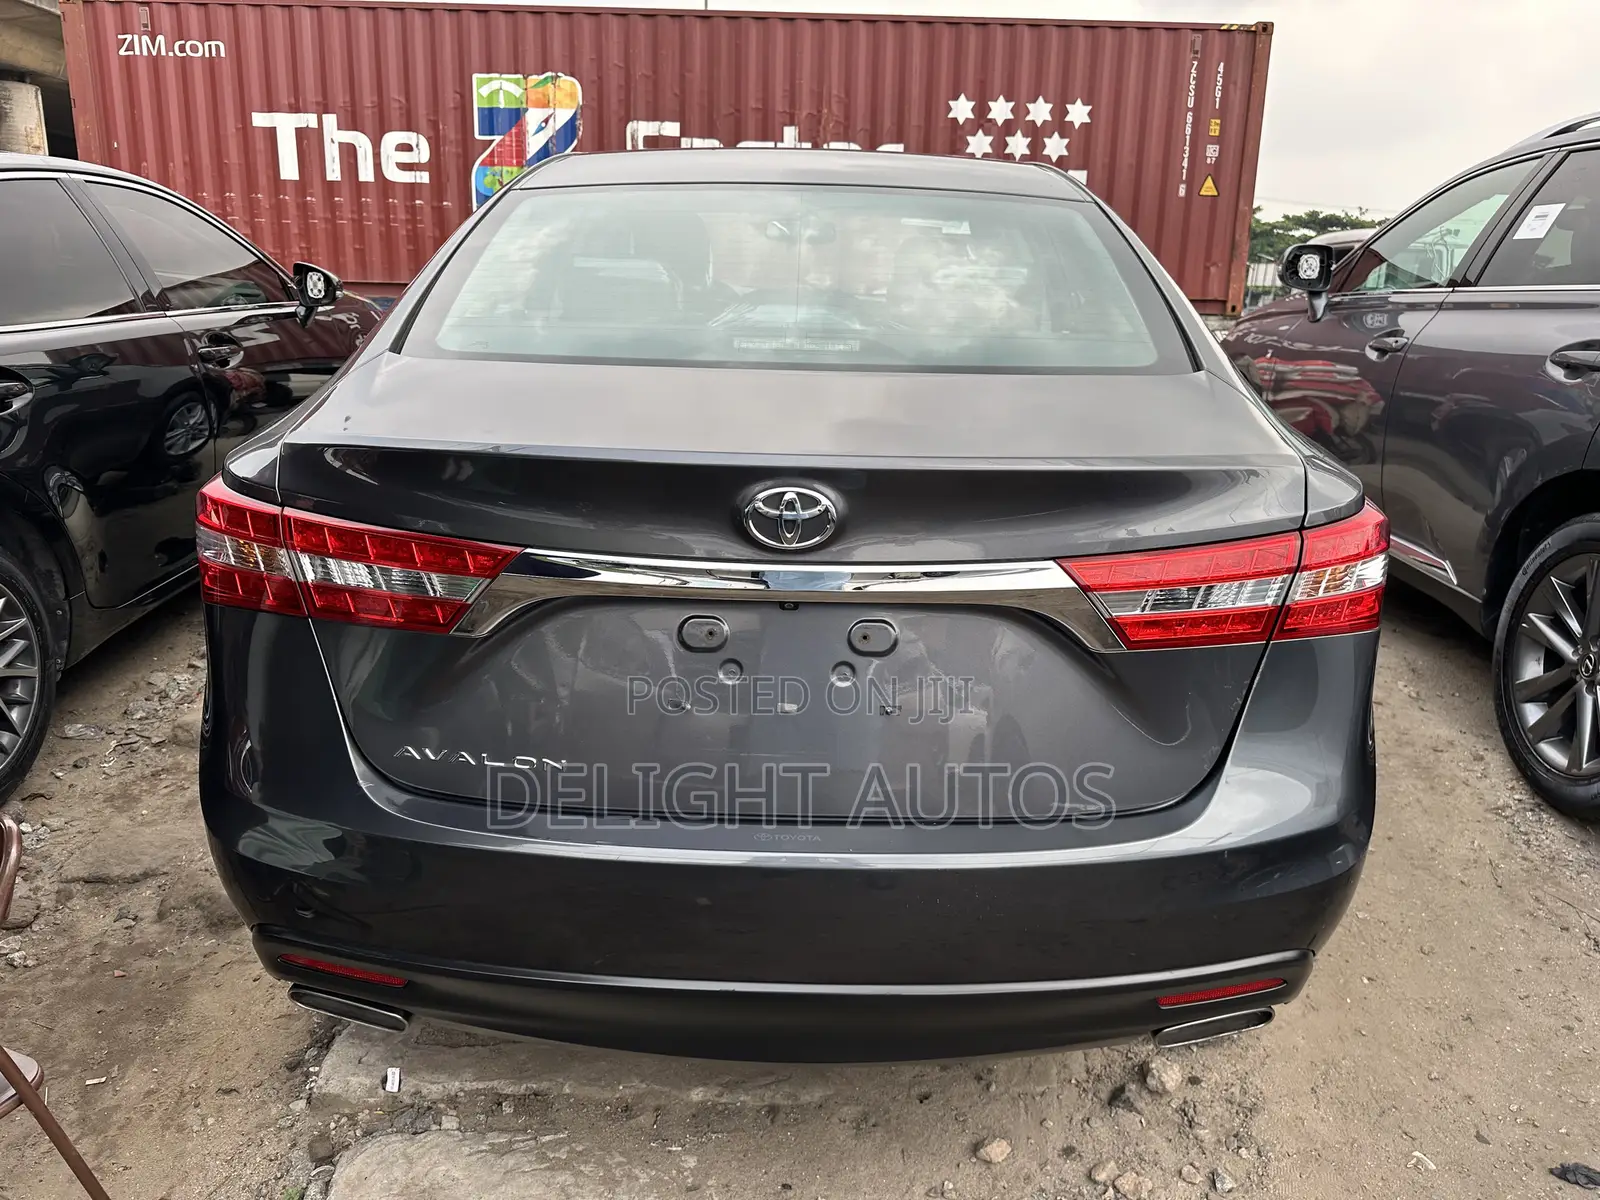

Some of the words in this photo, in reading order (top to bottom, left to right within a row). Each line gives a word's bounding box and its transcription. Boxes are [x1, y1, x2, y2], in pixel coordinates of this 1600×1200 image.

[117, 34, 226, 58] ZIM.com
[1187, 61, 1198, 109] ZCSU
[251, 112, 431, 184] The
[1182, 111, 1193, 180] 661341
[393, 745, 568, 772] AVALON
[774, 833, 822, 842] TOYOTA
